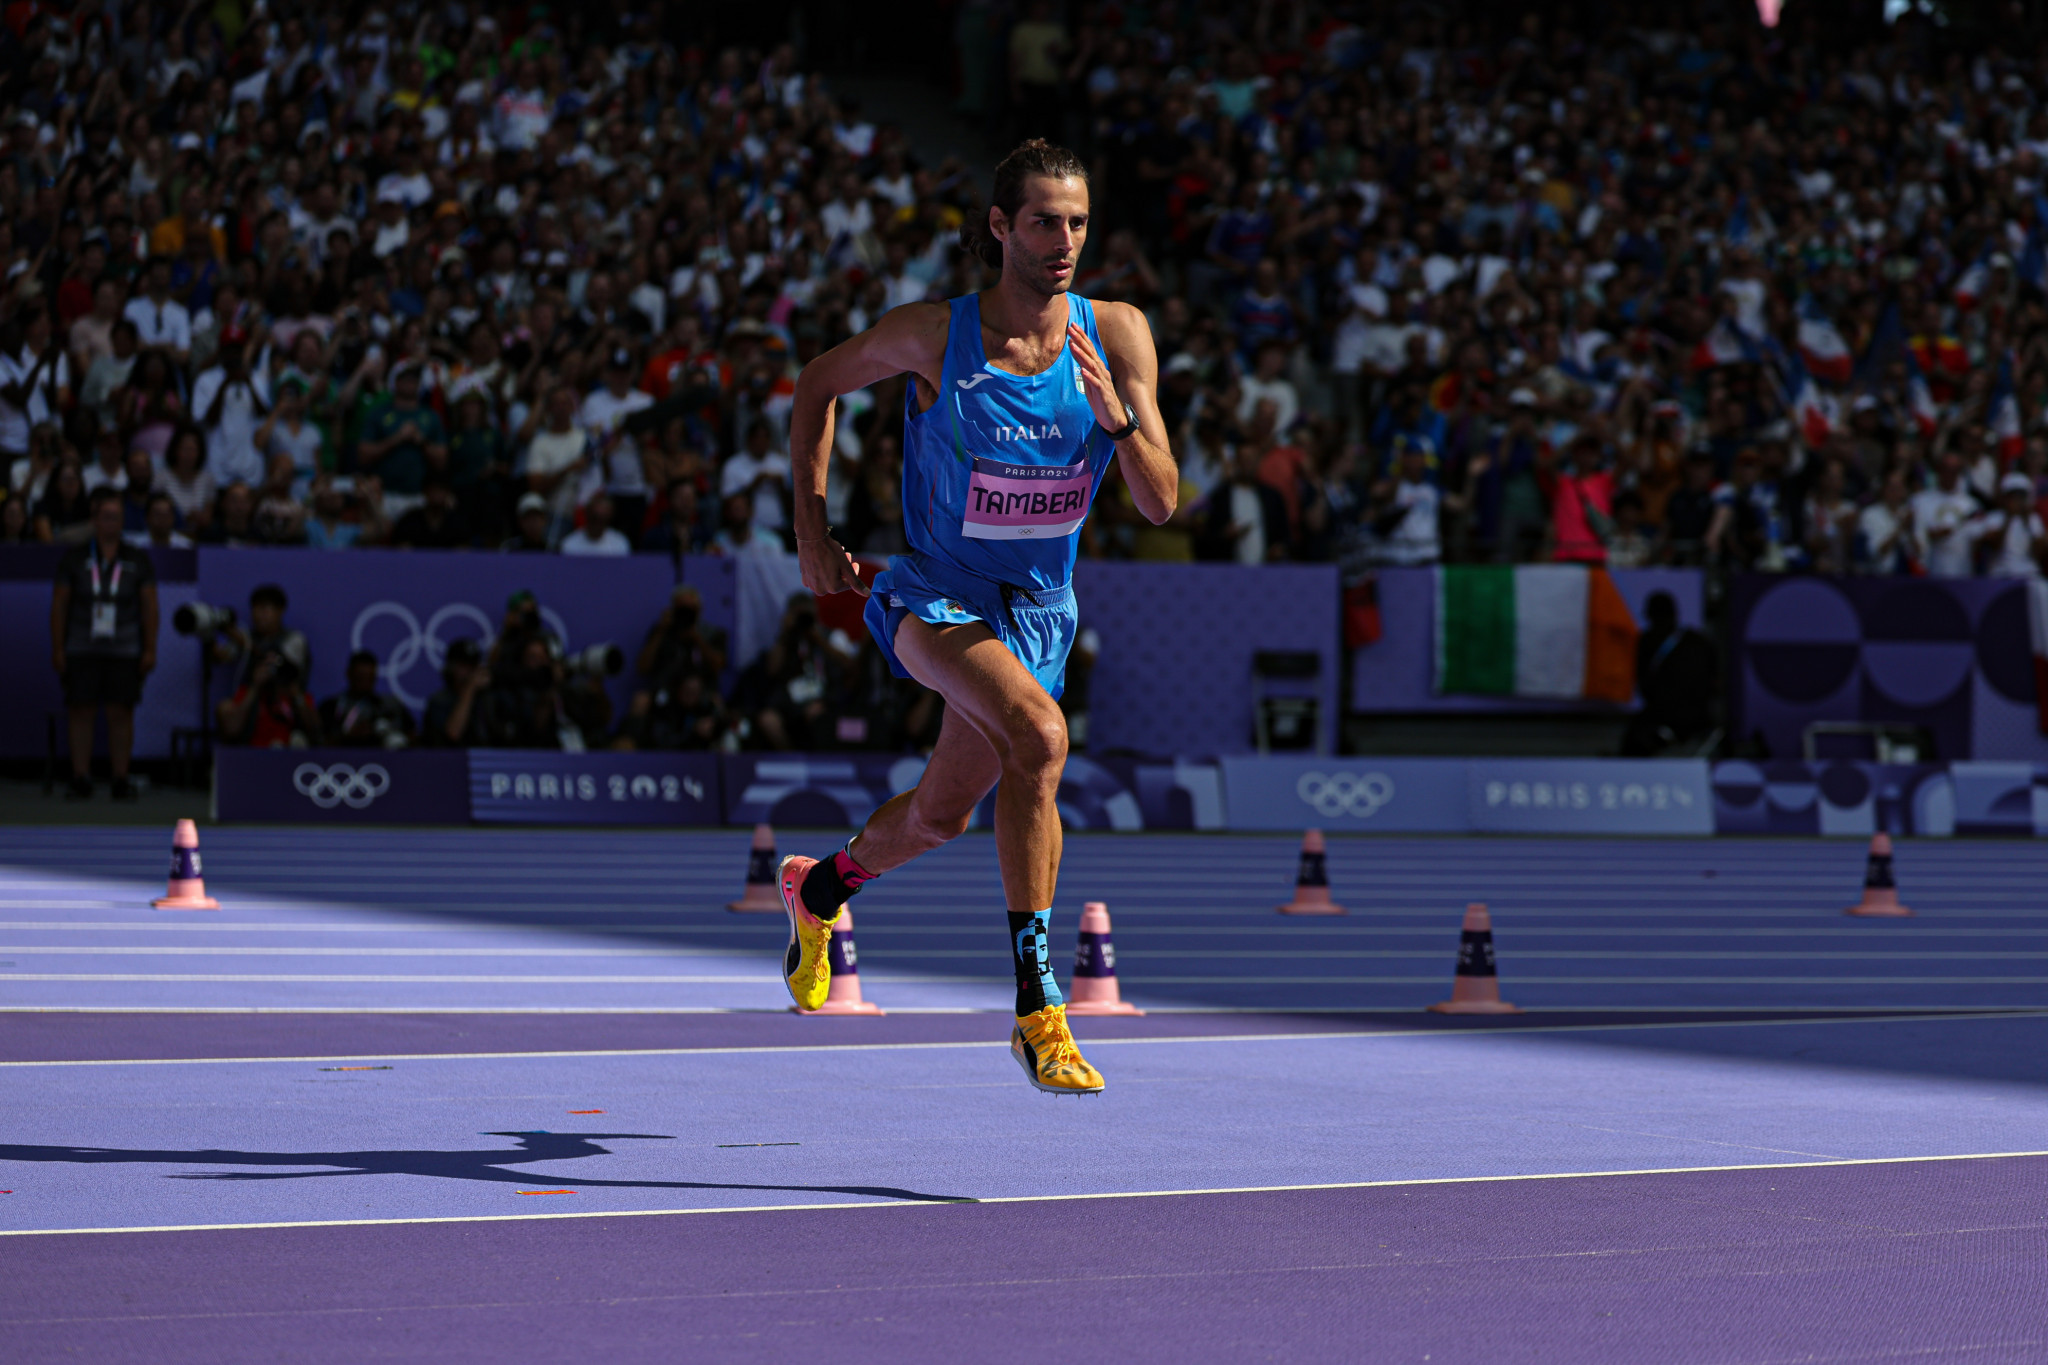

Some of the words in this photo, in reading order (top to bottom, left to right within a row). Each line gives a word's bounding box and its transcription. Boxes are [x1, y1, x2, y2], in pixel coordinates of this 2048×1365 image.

[996, 424, 1062, 441] ITALIA
[1005, 467, 1037, 477] PARIS
[1040, 469, 1068, 477] 2024
[973, 486, 1086, 515] TAMBERI
[491, 773, 597, 801] PARIS
[607, 774, 704, 802] 2024
[1485, 781, 1591, 809] PARIS
[1601, 782, 1694, 810] 2024
